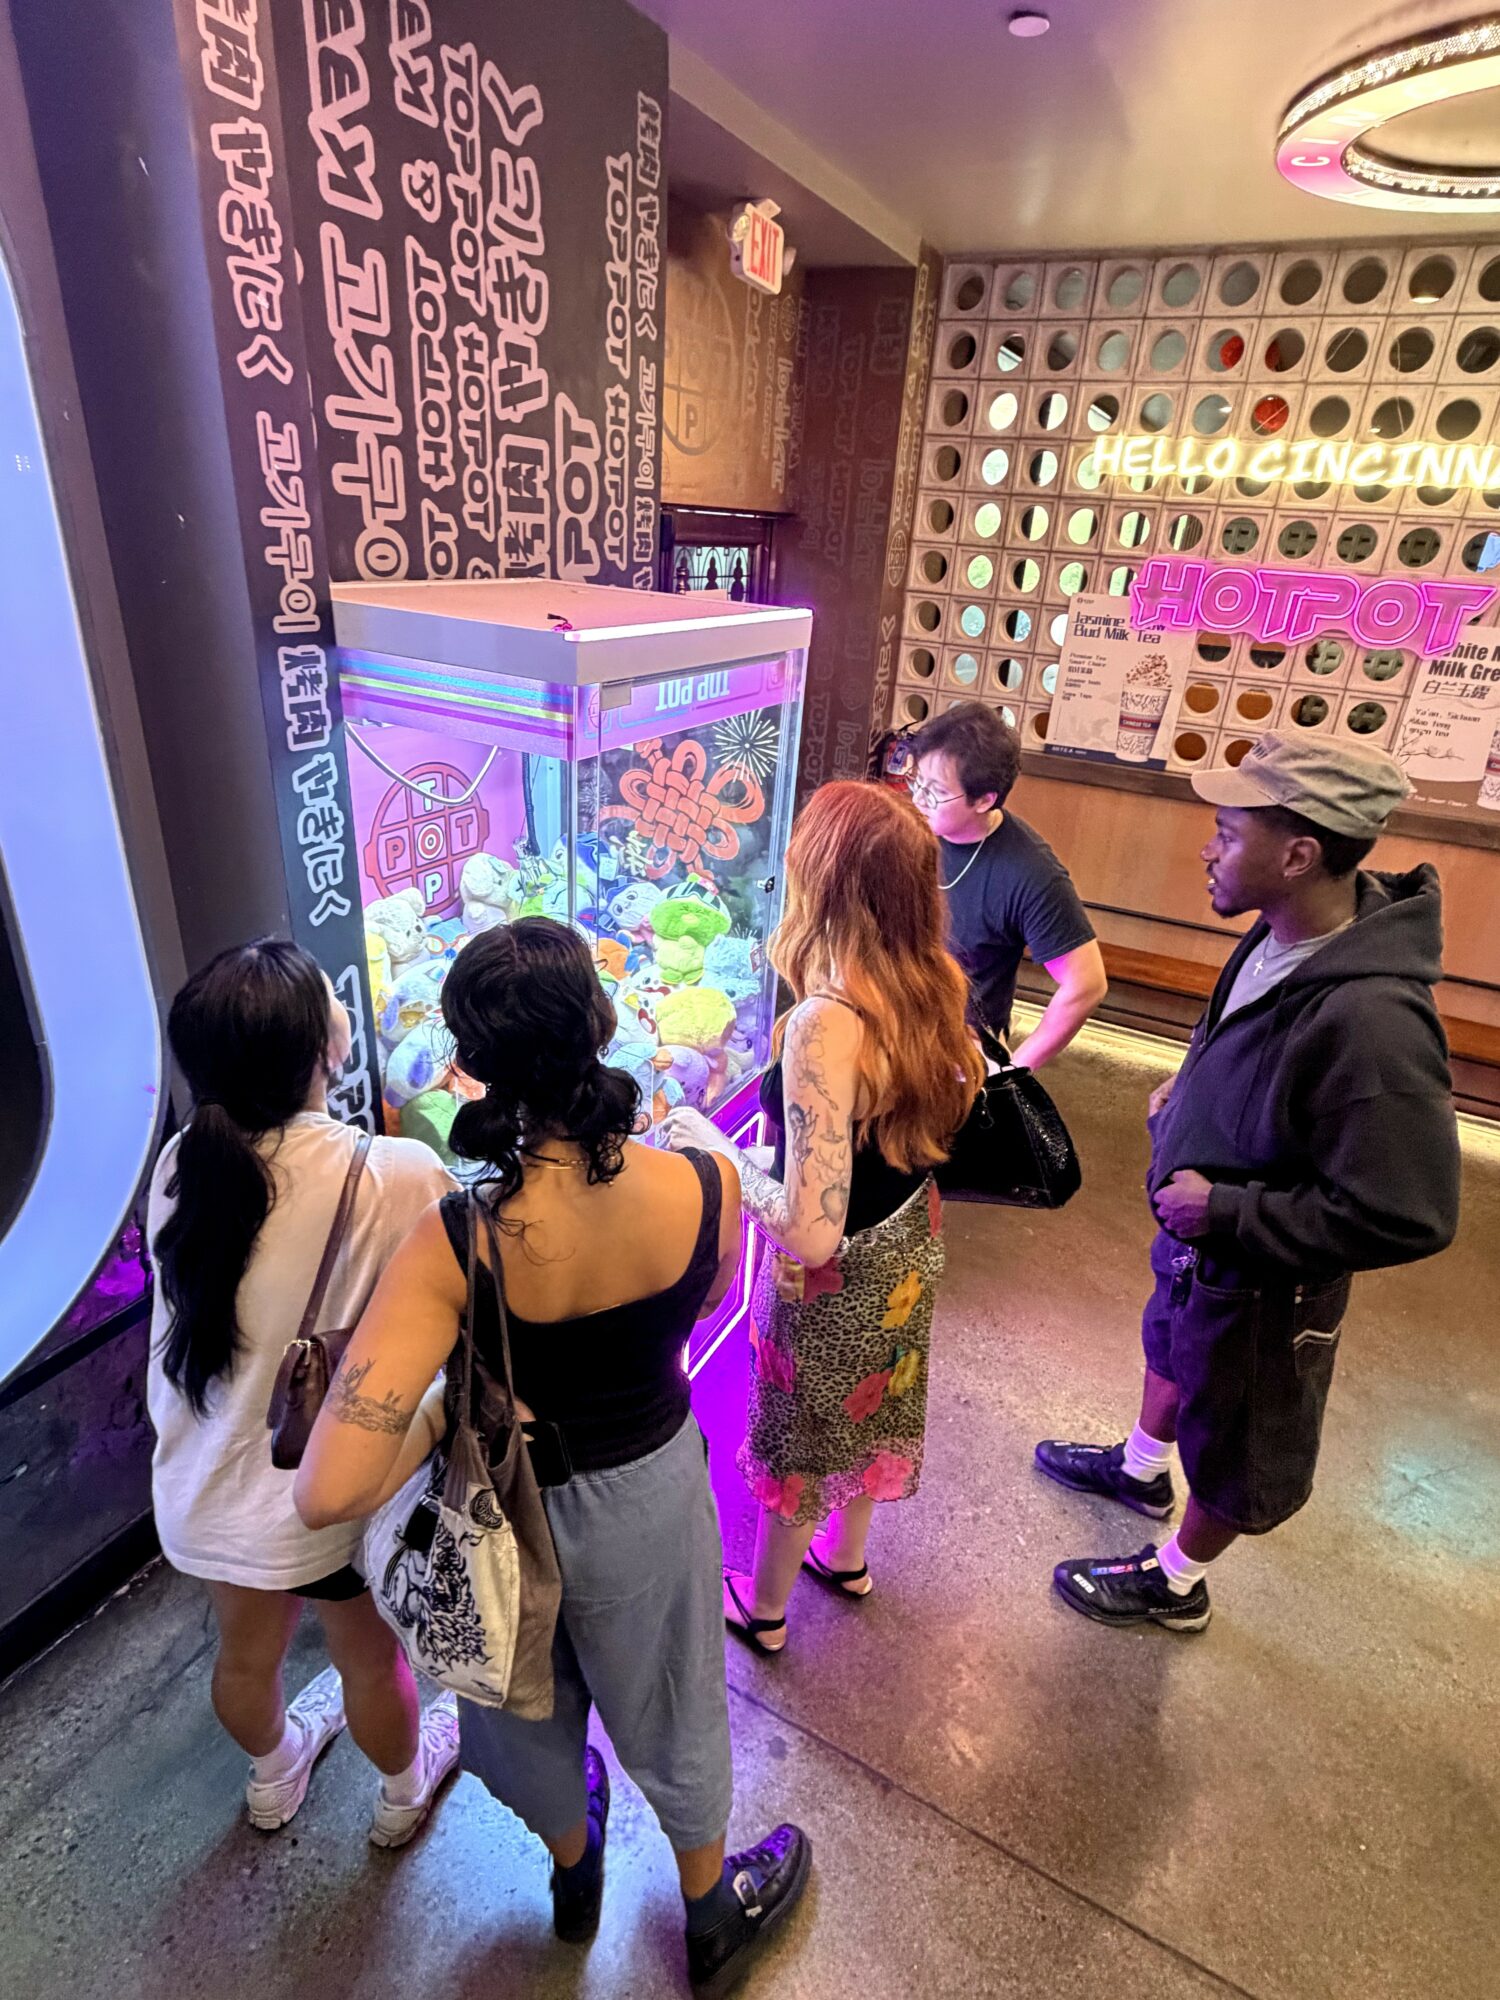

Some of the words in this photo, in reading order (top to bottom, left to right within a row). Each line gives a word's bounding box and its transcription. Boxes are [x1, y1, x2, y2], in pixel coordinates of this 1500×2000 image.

[750, 211, 779, 286] EXIT
[406, 236, 456, 492] HOTPOT
[454, 321, 494, 541] HOTPOT
[635, 356, 656, 489] 고기구이
[1093, 436, 1238, 478] HELLO
[256, 410, 321, 633] 고기구이
[604, 384, 631, 571] HOTPOT
[1072, 611, 1126, 628] Jasmine
[1073, 624, 1100, 639] Bud
[1104, 627, 1130, 641] Milk
[1137, 629, 1161, 644] Tea
[1132, 560, 1498, 656] HOTPOT
[1441, 642, 1488, 661] hite
[278, 644, 332, 752] 烤肉
[1428, 659, 1467, 679] Milk
[292, 752, 351, 927] やきにく
